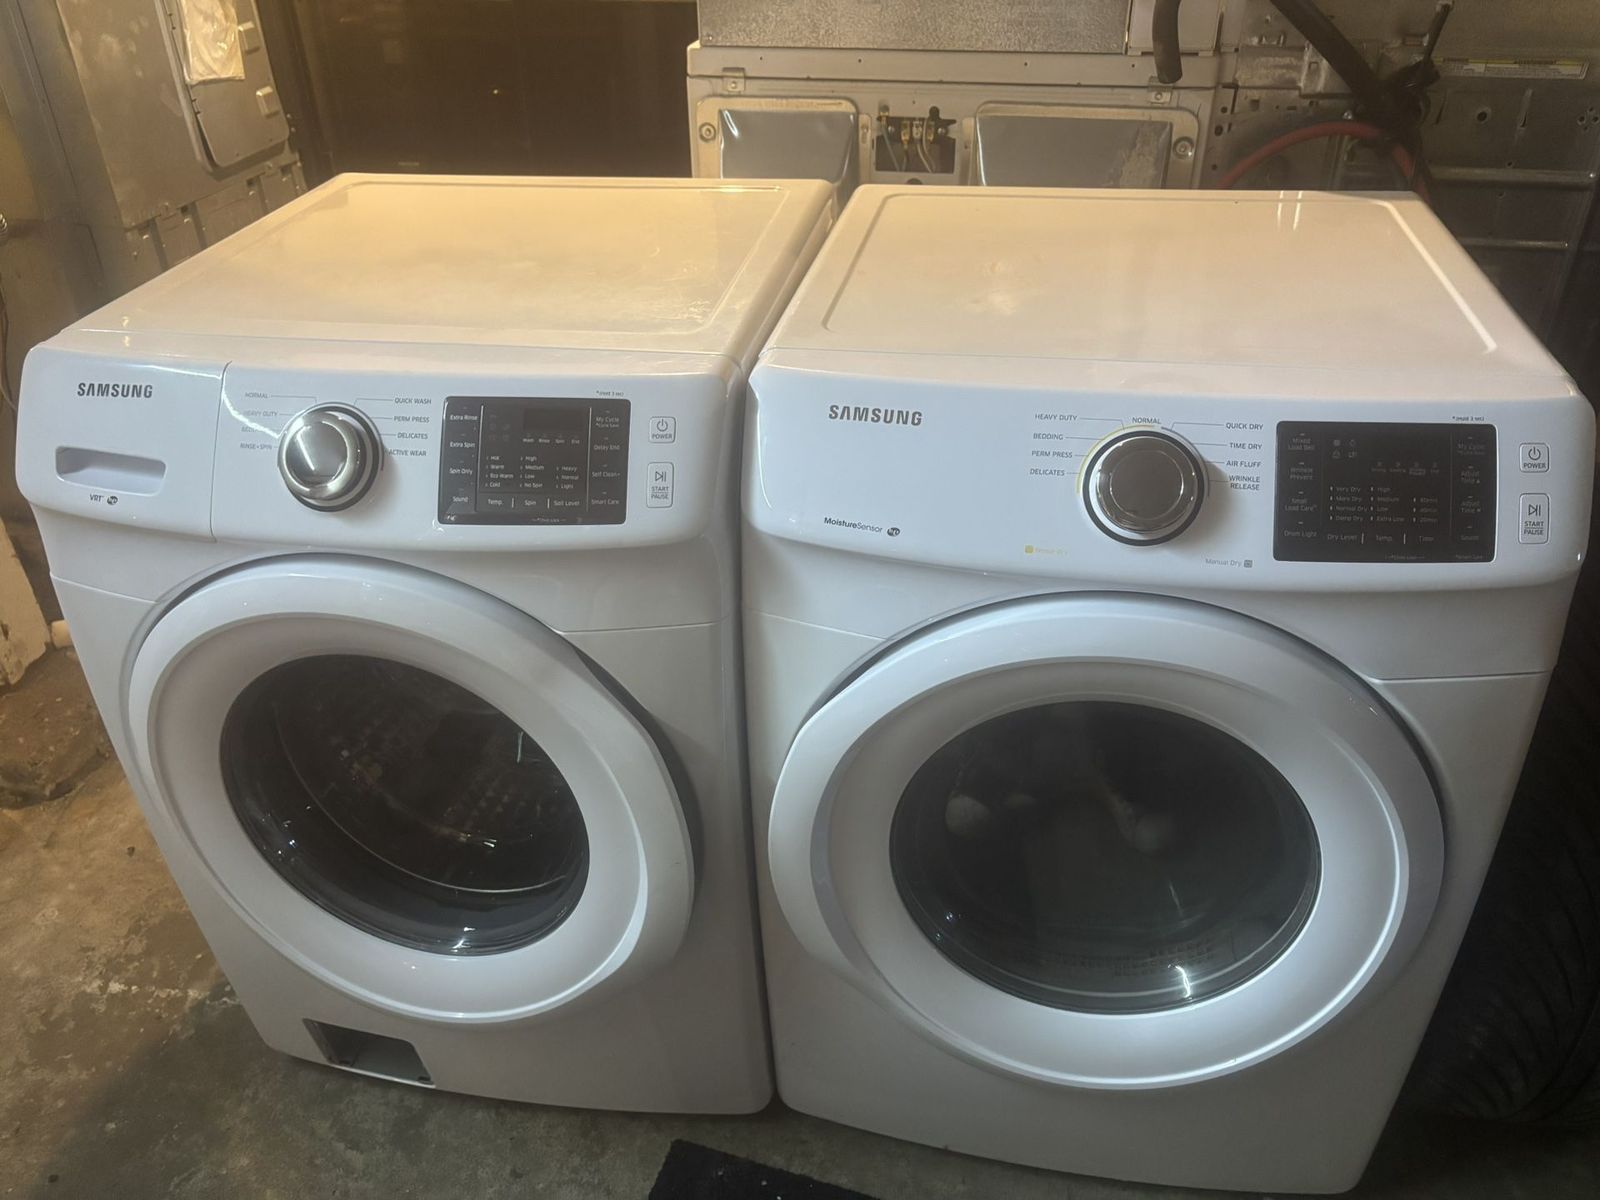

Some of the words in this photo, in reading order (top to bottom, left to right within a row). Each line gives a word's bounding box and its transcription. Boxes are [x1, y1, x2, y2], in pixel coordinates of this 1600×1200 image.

[77, 382, 153, 399] SAMSUNG
[244, 391, 268, 399] NORMAL
[828, 404, 923, 426] SAMSUNG
[1034, 413, 1058, 421] HEAVY
[1131, 416, 1162, 425] NORMAL
[1225, 422, 1248, 430] QUICK
[397, 432, 428, 440] DELICATES
[1033, 432, 1064, 441] BEDDING
[464, 441, 475, 449] Spin
[1229, 442, 1247, 450] TIME
[449, 467, 460, 475] Spin
[461, 468, 473, 476] Only
[1029, 468, 1065, 476] DELICATES
[1228, 475, 1261, 483] WRINKLE
[1230, 483, 1260, 491] RELEASE
[524, 499, 537, 507] Spin
[823, 517, 883, 533] MoistureSensor
[1205, 558, 1229, 566] Manual
[1230, 559, 1242, 568] Dry
